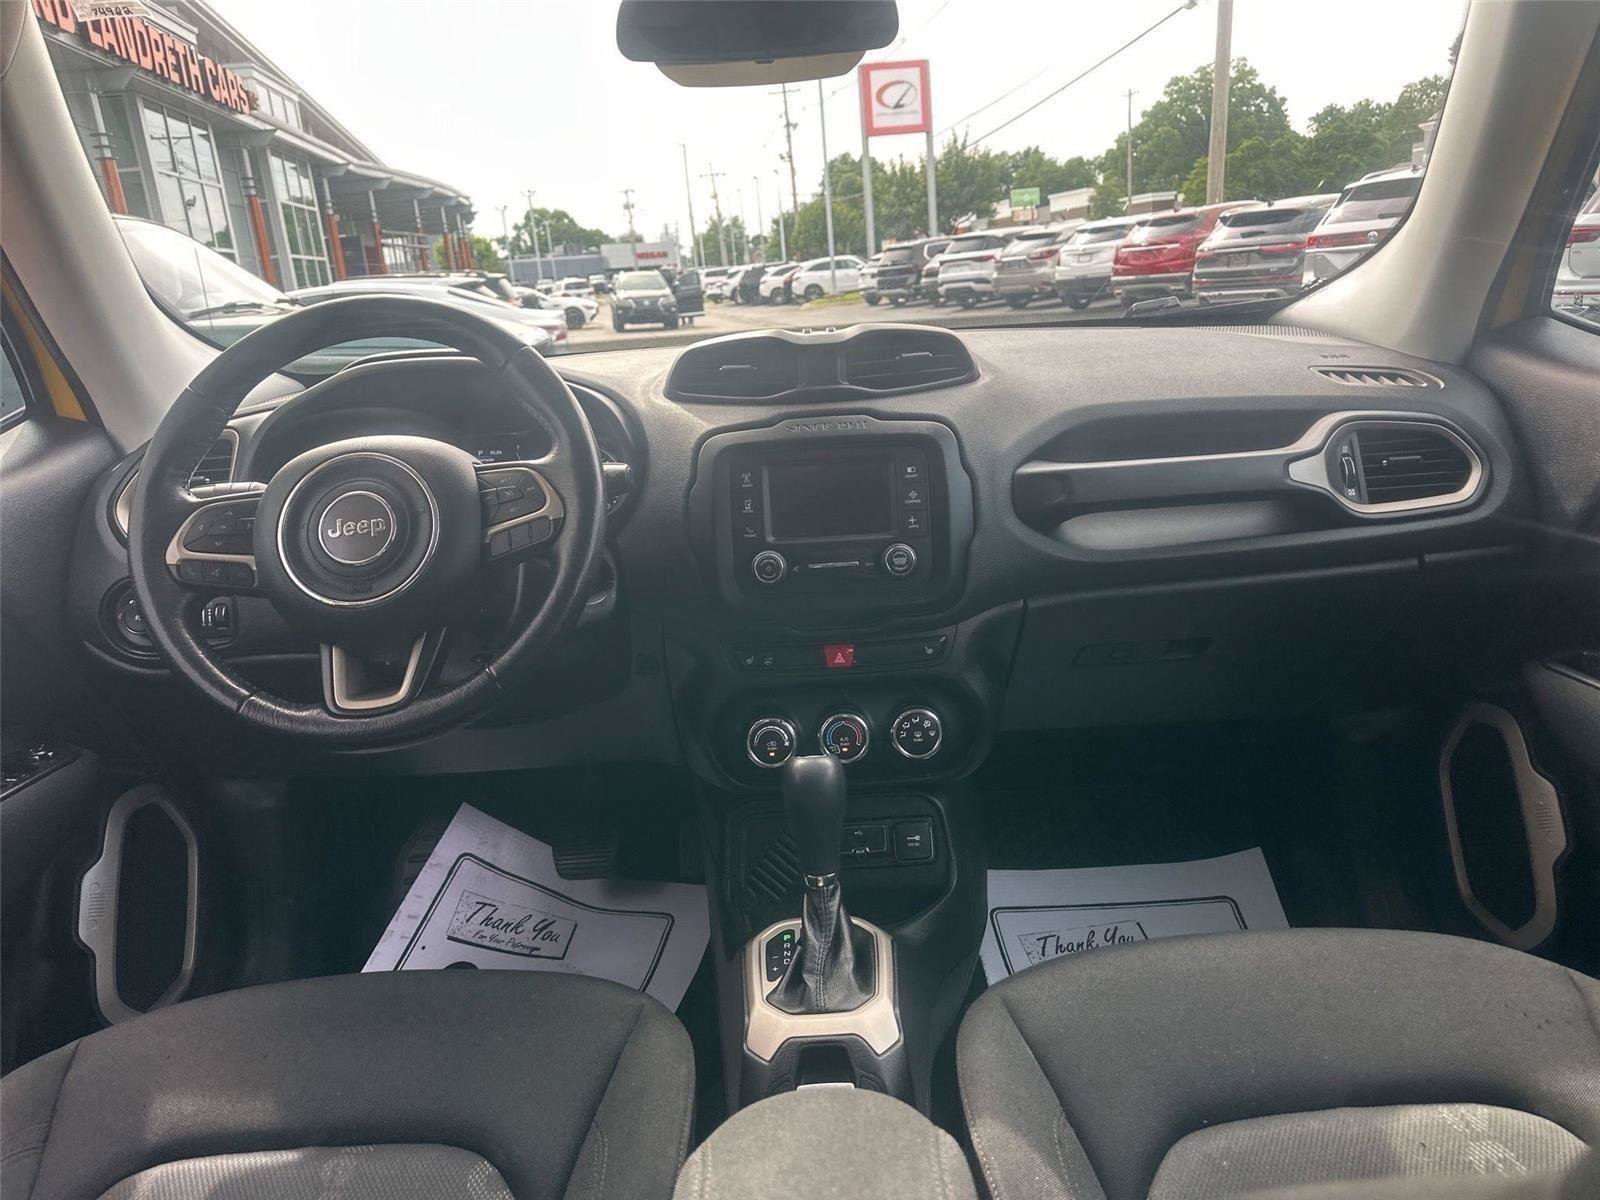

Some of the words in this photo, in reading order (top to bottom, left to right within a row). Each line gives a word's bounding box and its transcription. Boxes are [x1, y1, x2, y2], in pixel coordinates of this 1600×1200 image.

[91, 6, 133, 17] 74922
[87, 16, 204, 94] LANDRETH
[204, 57, 251, 114] CARS
[327, 518, 387, 538] Jeep
[466, 901, 533, 934] Thank
[532, 918, 561, 943] You
[1035, 929, 1100, 957] Thank
